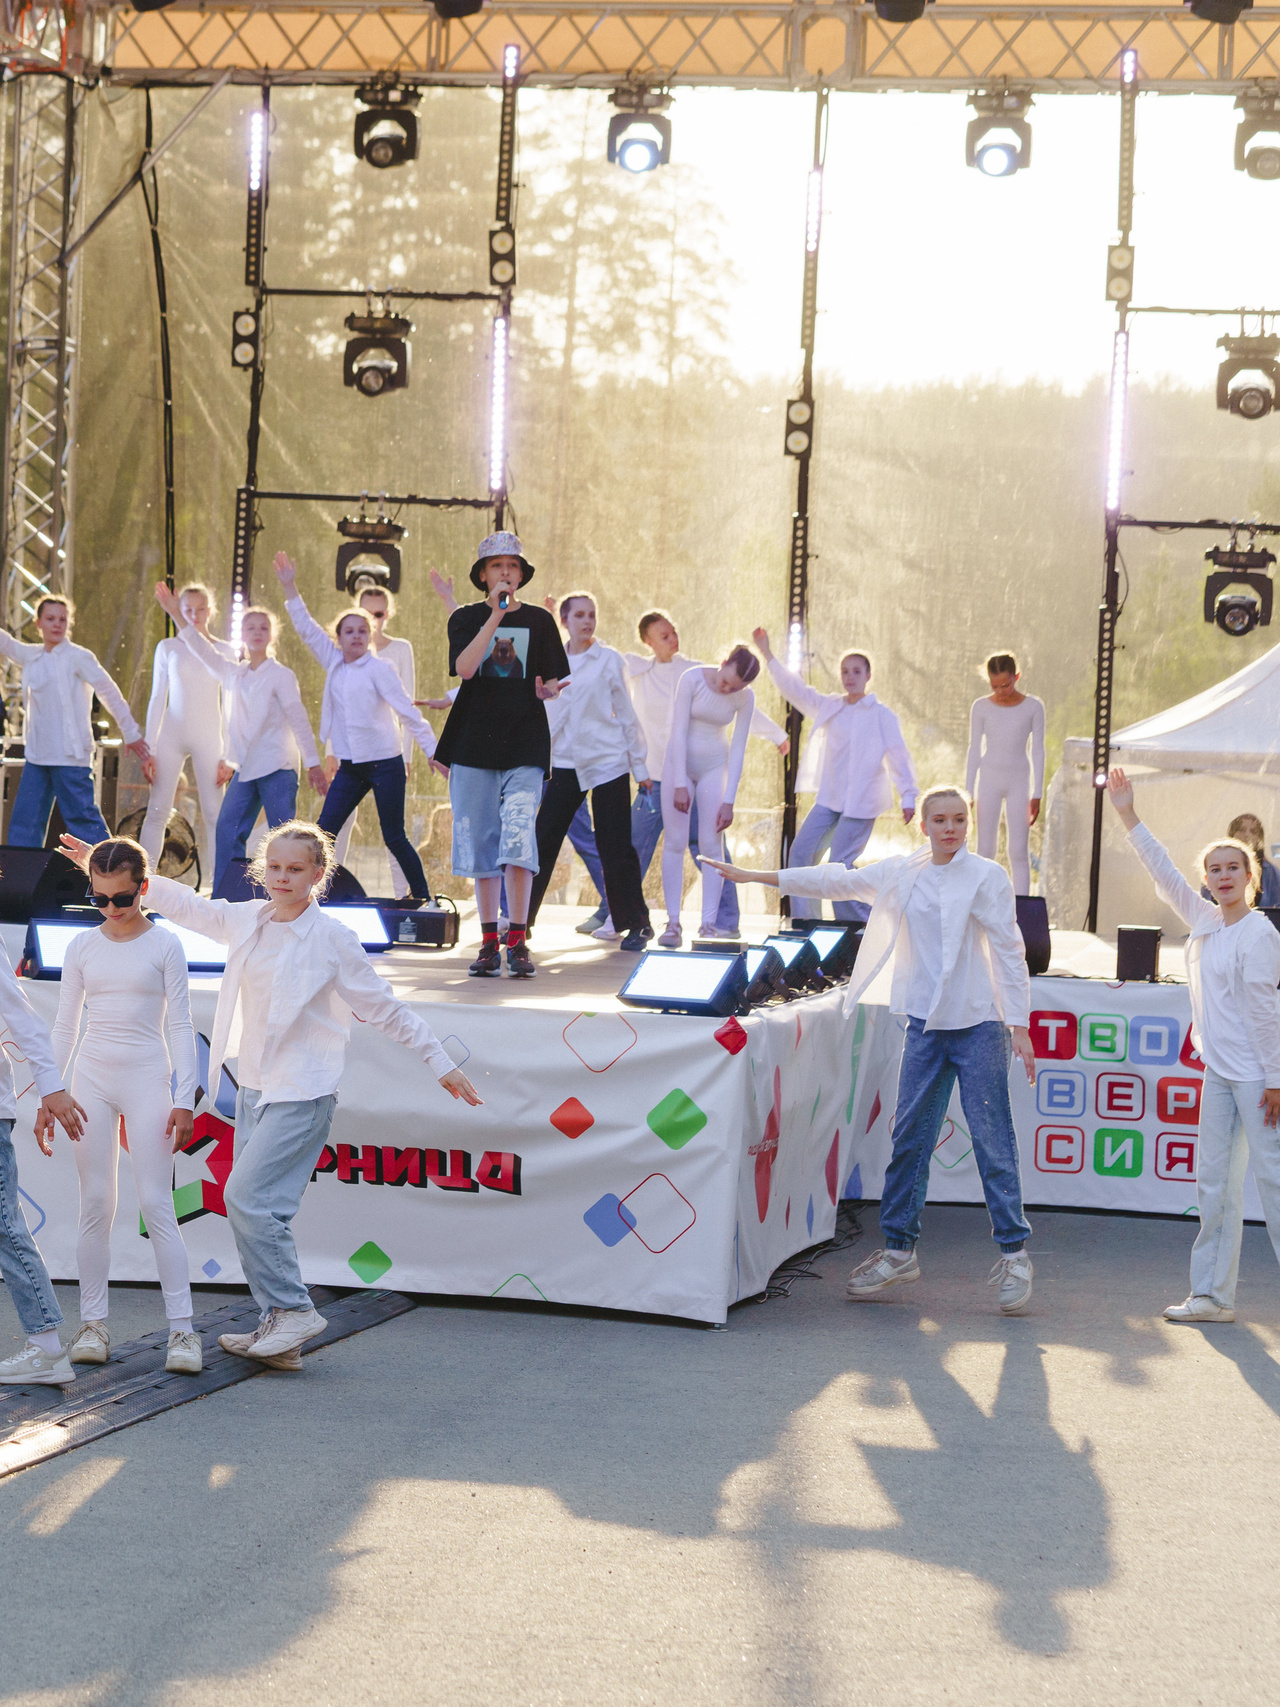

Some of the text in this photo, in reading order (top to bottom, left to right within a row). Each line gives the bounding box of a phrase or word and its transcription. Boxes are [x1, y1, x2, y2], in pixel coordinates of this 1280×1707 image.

[1037, 1018, 1203, 1061] ТВО
[1046, 1077, 1198, 1116] ВЕР
[1045, 1133, 1195, 1174] СИЯ
